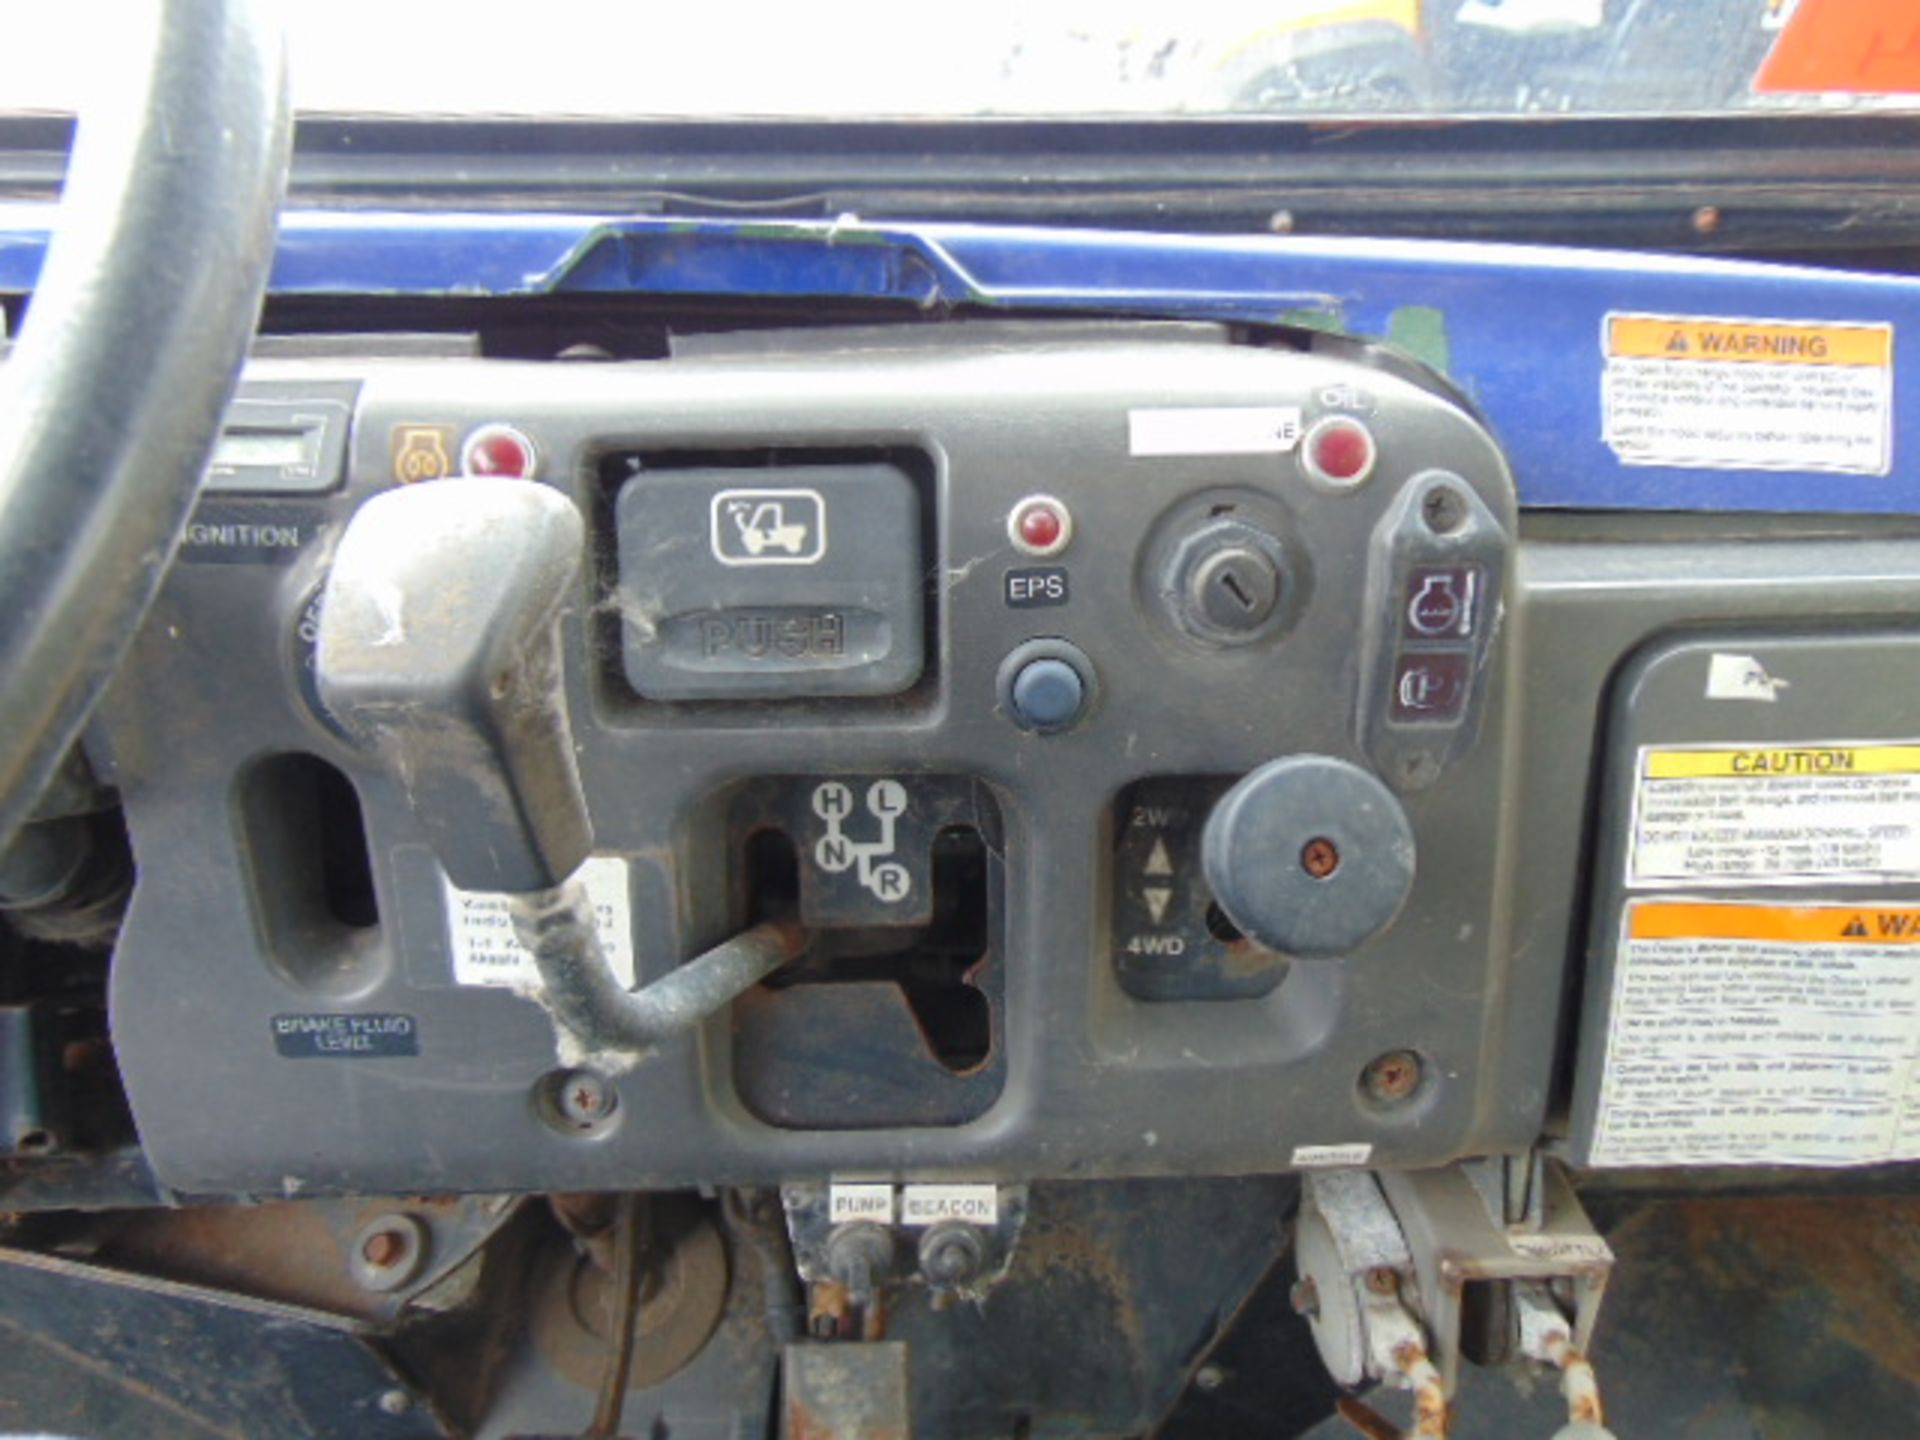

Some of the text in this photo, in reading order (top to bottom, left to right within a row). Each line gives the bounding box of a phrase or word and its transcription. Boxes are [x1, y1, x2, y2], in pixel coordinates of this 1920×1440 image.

[1698, 331, 1828, 357] WARNING
[1320, 388, 1368, 409] OIL
[182, 523, 299, 547] IGNITION
[1009, 574, 1063, 599] EPS
[702, 614, 844, 660] PUSH
[1732, 752, 1854, 774] CAUTION
[821, 788, 844, 814] H
[878, 788, 898, 812] L
[823, 839, 847, 865] N
[880, 869, 900, 894] R
[1127, 935, 1185, 955] 4WD
[835, 1197, 991, 1217] PUMP BEACON
